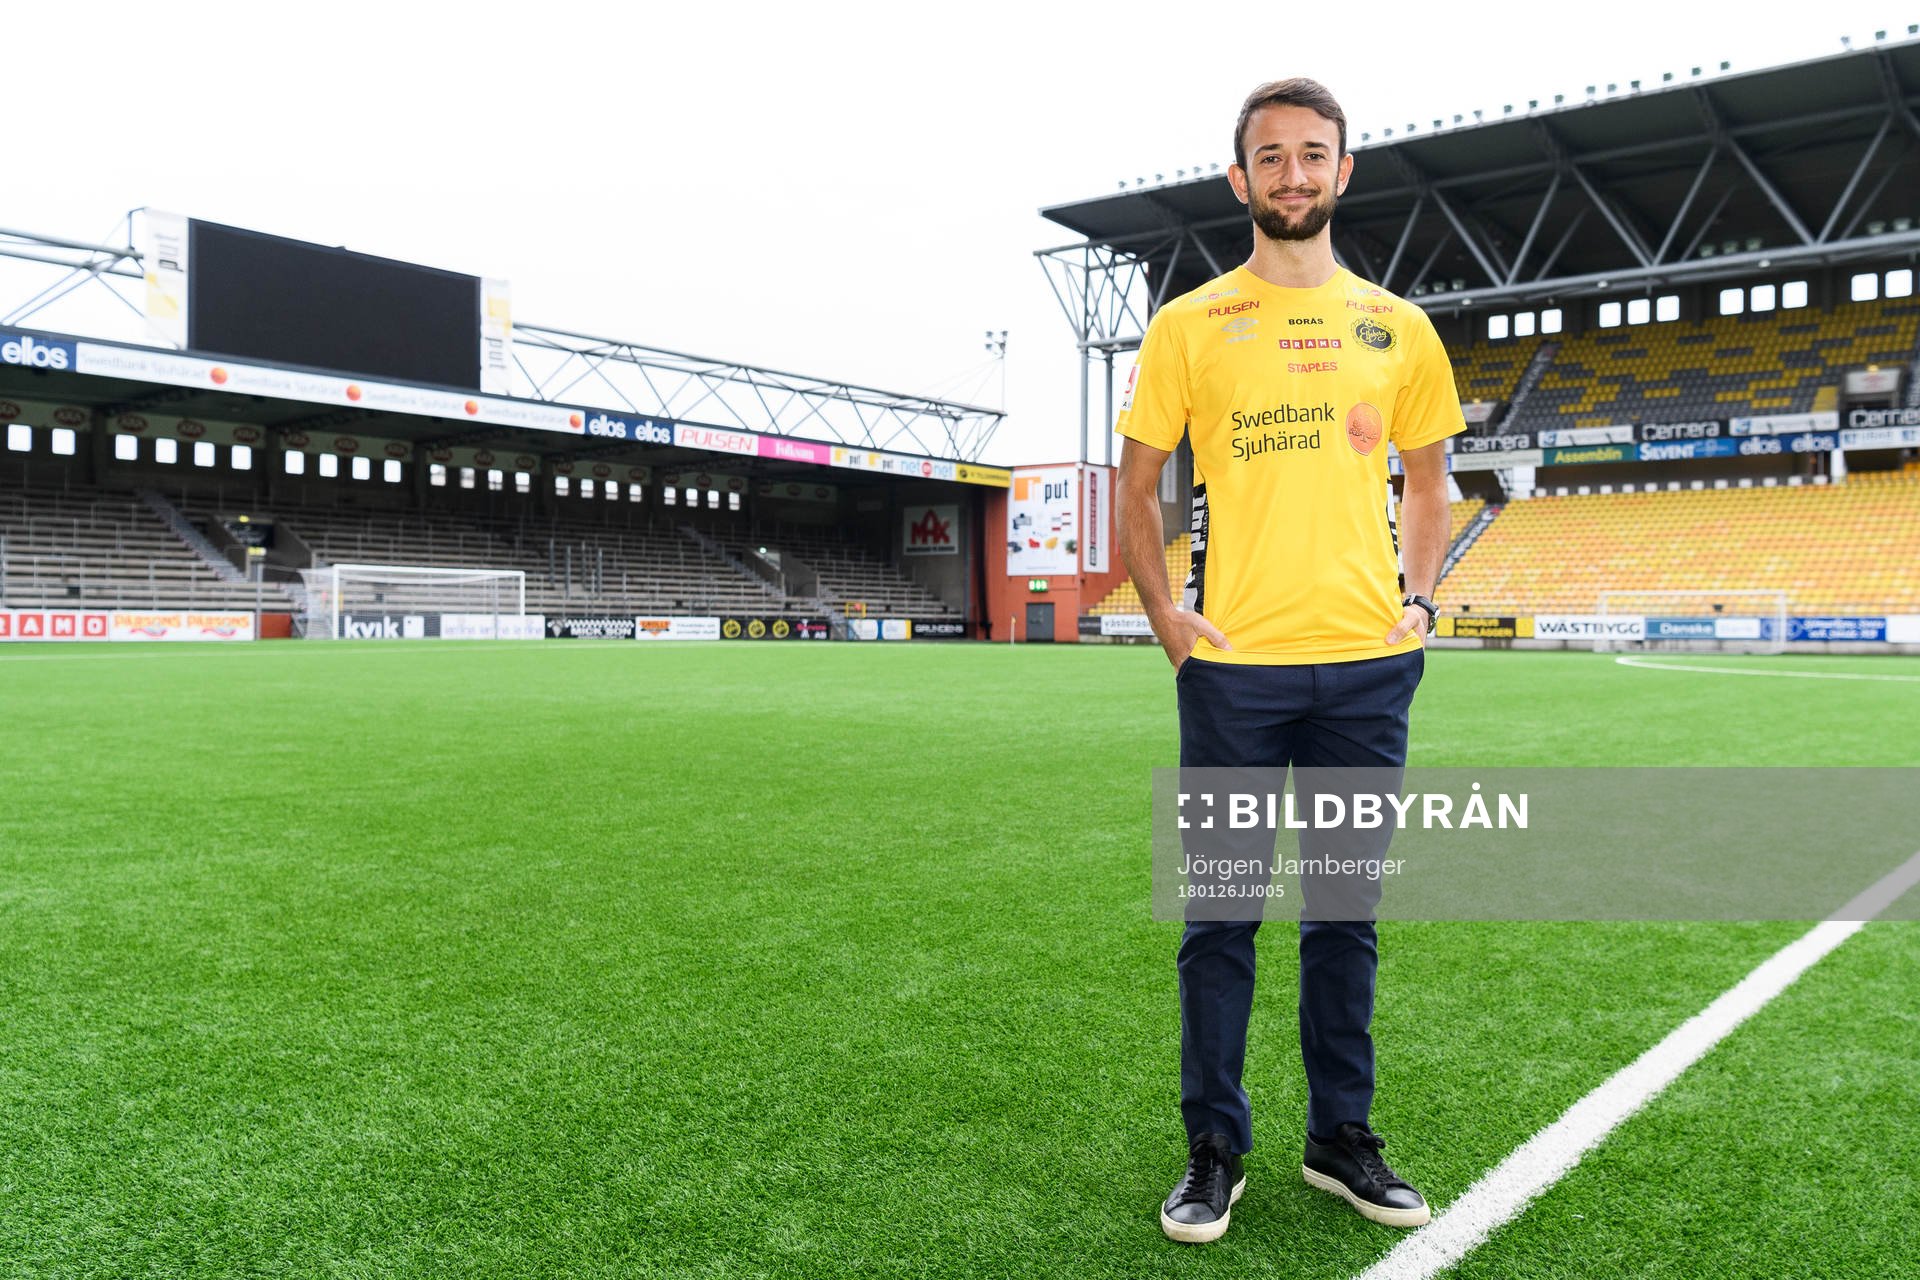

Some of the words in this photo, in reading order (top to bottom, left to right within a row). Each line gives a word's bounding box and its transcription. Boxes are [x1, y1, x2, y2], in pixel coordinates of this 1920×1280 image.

[1208, 300, 1260, 318] PULSEN
[1346, 299, 1393, 314] PULSEN
[1288, 317, 1324, 326] BORÅS
[1, 336, 69, 370] ellos
[1280, 339, 1341, 349] CRAMO
[1287, 362, 1338, 373] STAPLES
[1232, 402, 1336, 431] Swedbank
[589, 415, 626, 438] ellos
[635, 420, 671, 444] ellos
[680, 428, 753, 451] PULSEN
[1232, 430, 1321, 462] Sjuhärad
[1554, 448, 1623, 464] Assemblin
[1044, 479, 1069, 504] put
[344, 615, 399, 639] kvik
[1538, 620, 1641, 635] WÄSTBYGG
